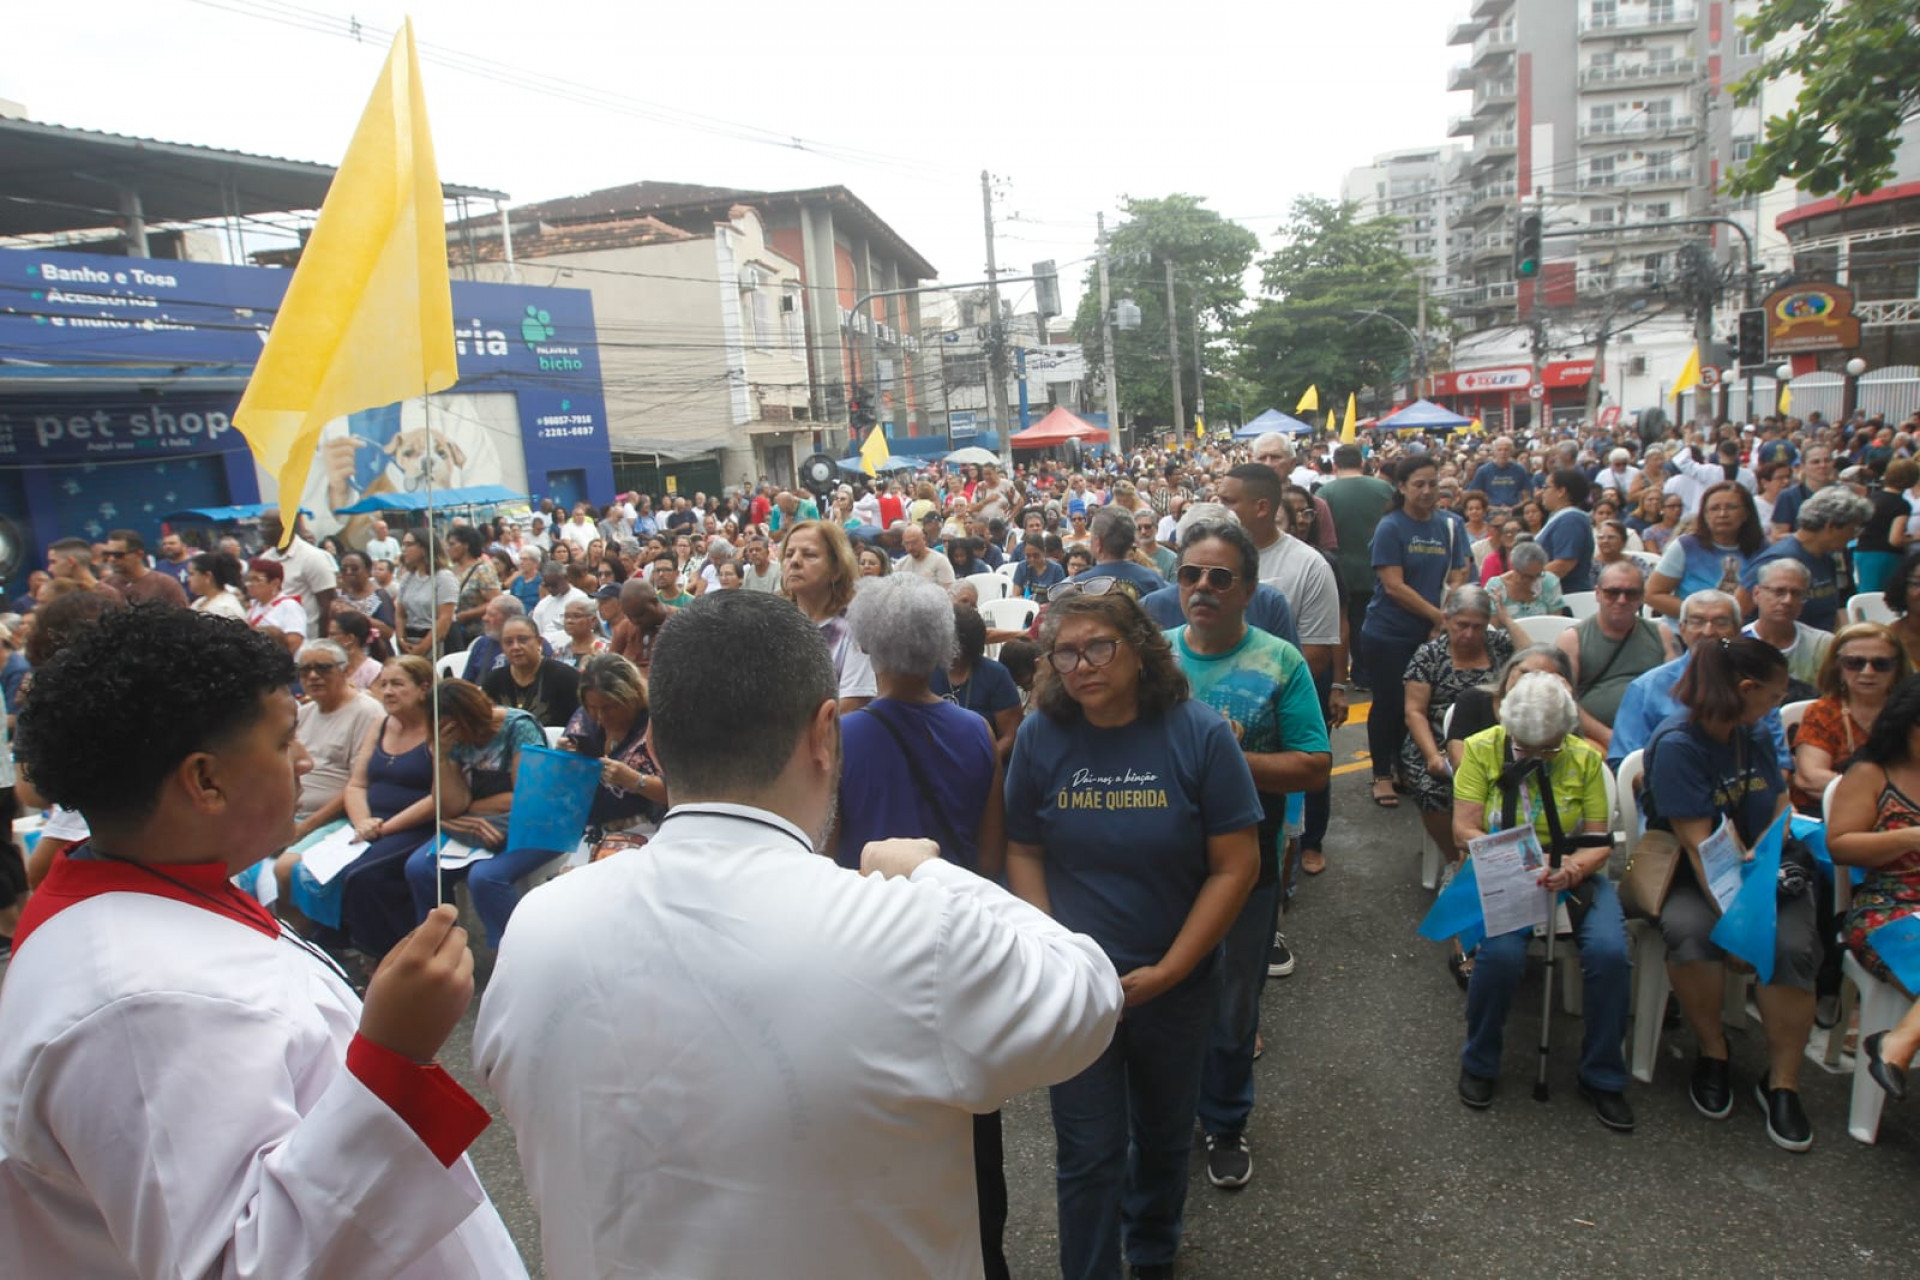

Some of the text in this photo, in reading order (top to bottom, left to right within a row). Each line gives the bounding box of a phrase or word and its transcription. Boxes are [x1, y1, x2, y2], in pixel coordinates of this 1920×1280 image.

[41, 264, 178, 287] Banho e Tosa
[539, 356, 582, 370] bicho
[35, 410, 114, 447] pet
[129, 405, 230, 439] shop
[1057, 787, 1168, 810] Ó MÃE QUERIDA
